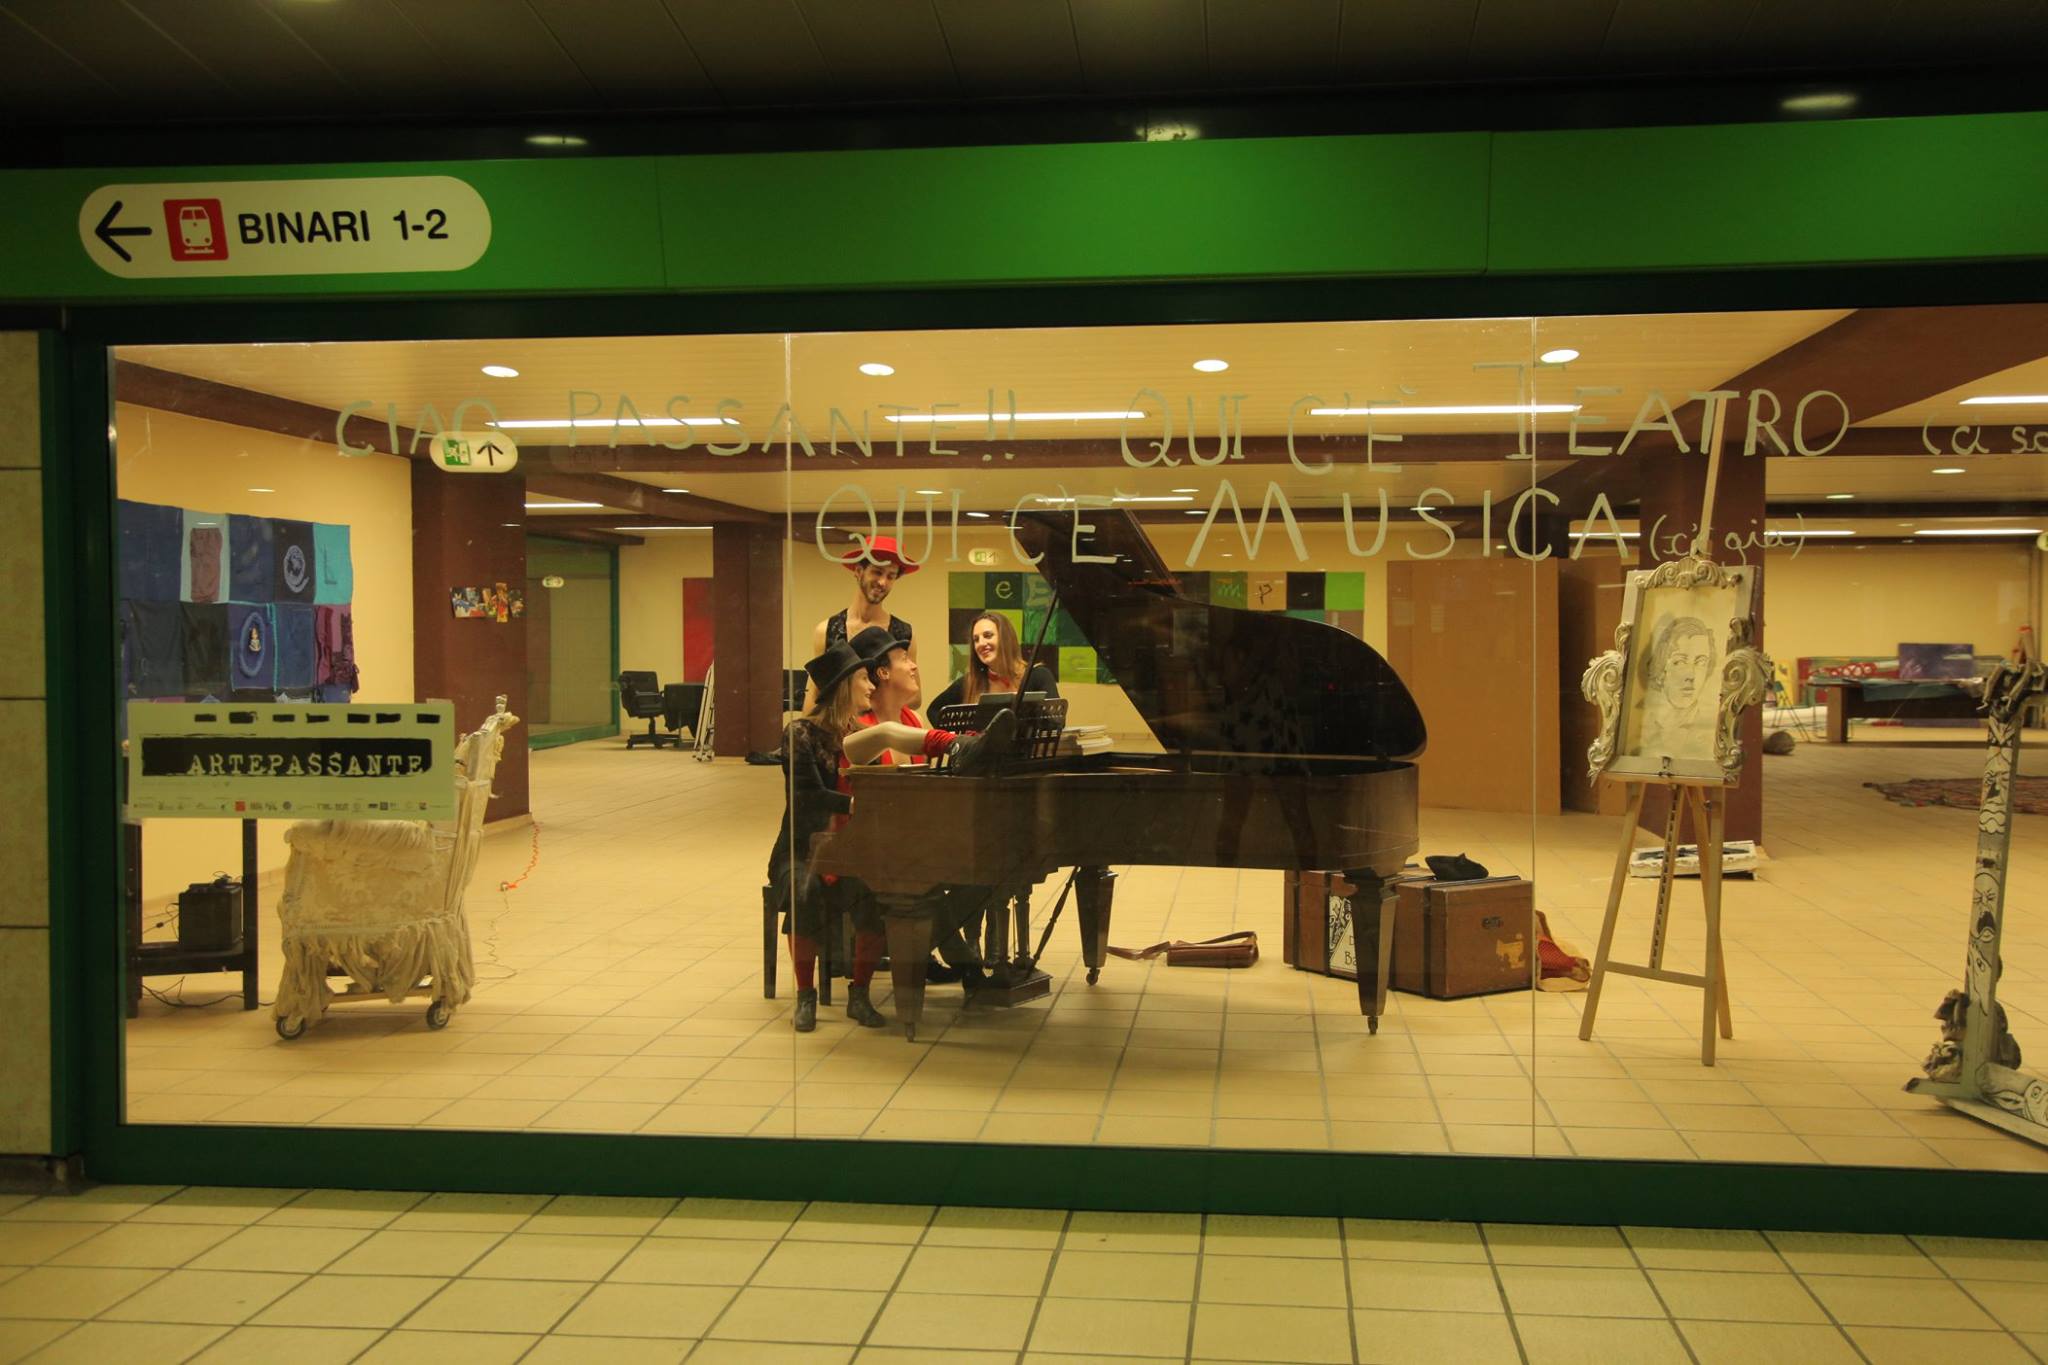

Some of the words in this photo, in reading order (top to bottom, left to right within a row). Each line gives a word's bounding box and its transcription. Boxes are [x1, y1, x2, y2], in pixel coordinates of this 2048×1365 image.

[238, 210, 370, 245] BINARI
[393, 208, 449, 240] 1-2
[568, 388, 1016, 461] PASSANTE!!
[1120, 387, 1248, 468] QUI
[1472, 361, 1850, 460] TEATRO
[815, 483, 967, 567] QUI
[1185, 479, 1628, 567] MUSICA
[186, 752, 424, 777] ARTEPASSANTE
